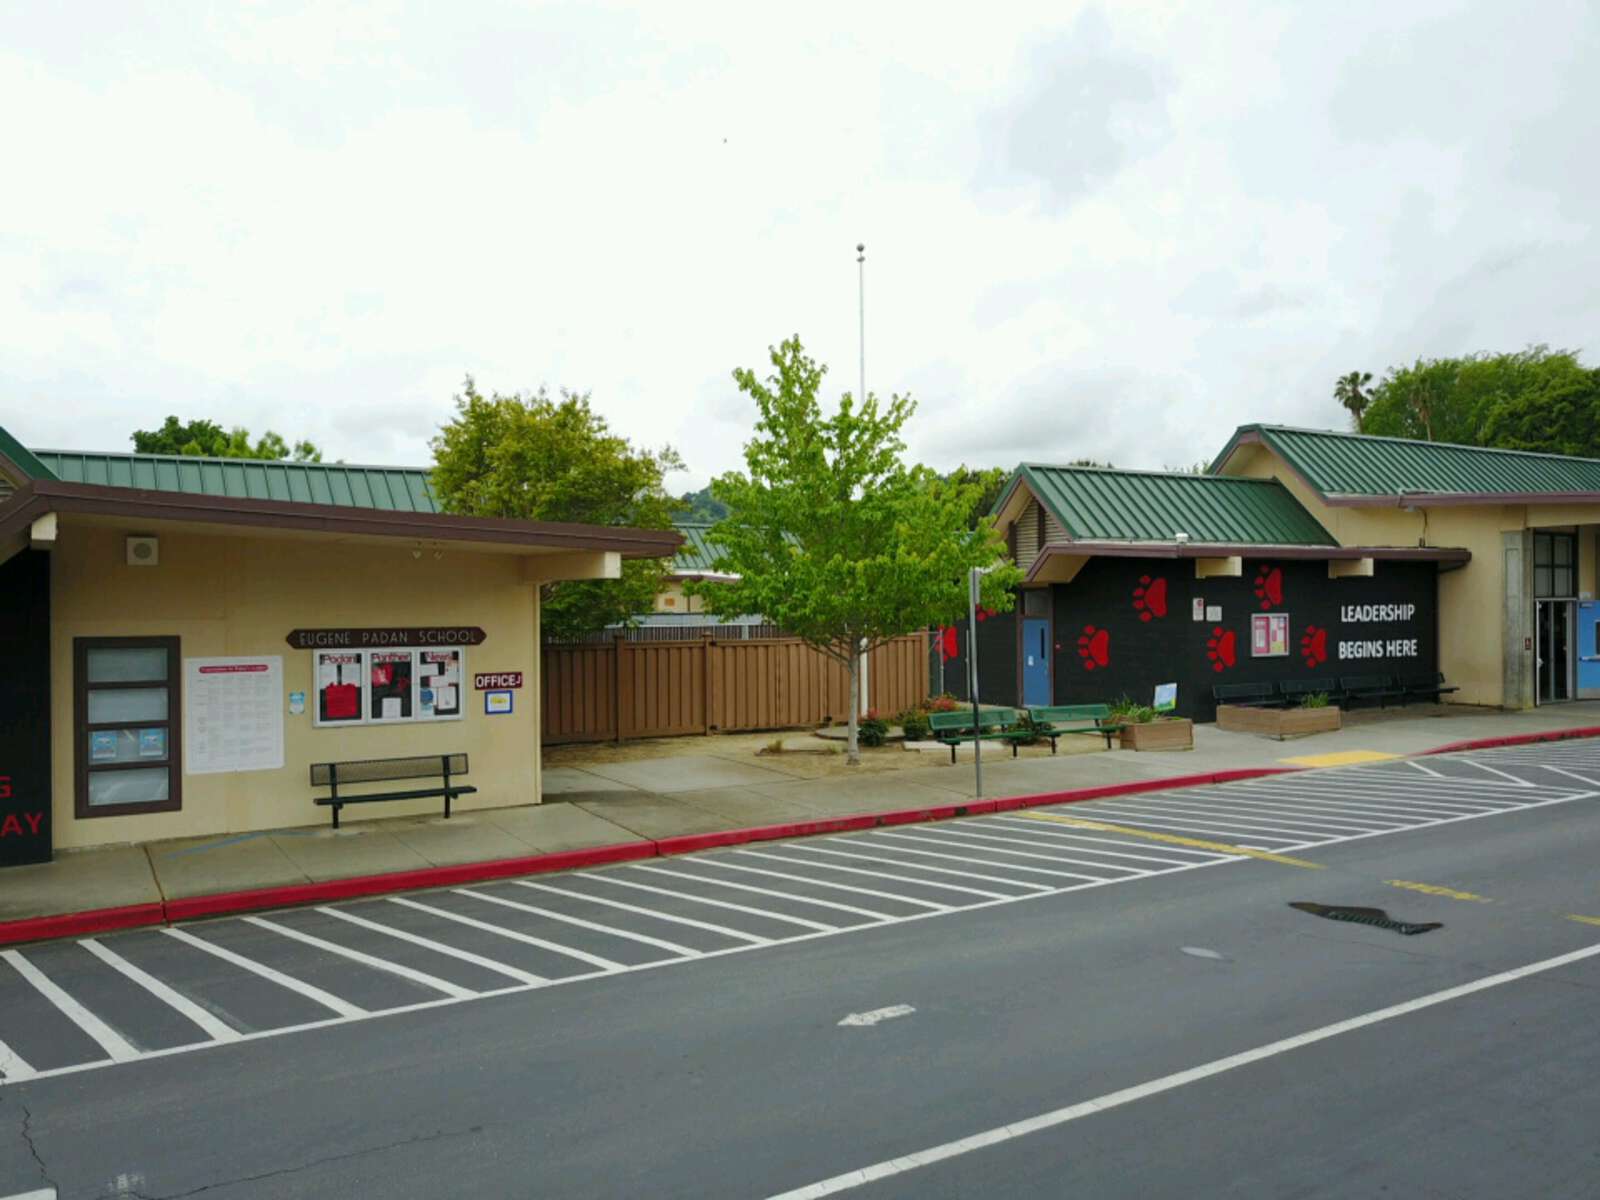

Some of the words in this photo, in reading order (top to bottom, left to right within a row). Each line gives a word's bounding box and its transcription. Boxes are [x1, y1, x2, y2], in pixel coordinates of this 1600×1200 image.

[1341, 604, 1416, 622] LEADERSHIP
[300, 632, 350, 646] EUGENE
[362, 631, 408, 644] PADAN
[419, 630, 476, 643] SCHOOL
[1339, 640, 1384, 660] BEGINS
[1386, 639, 1418, 657] HERE
[476, 674, 516, 688] OFFICE
